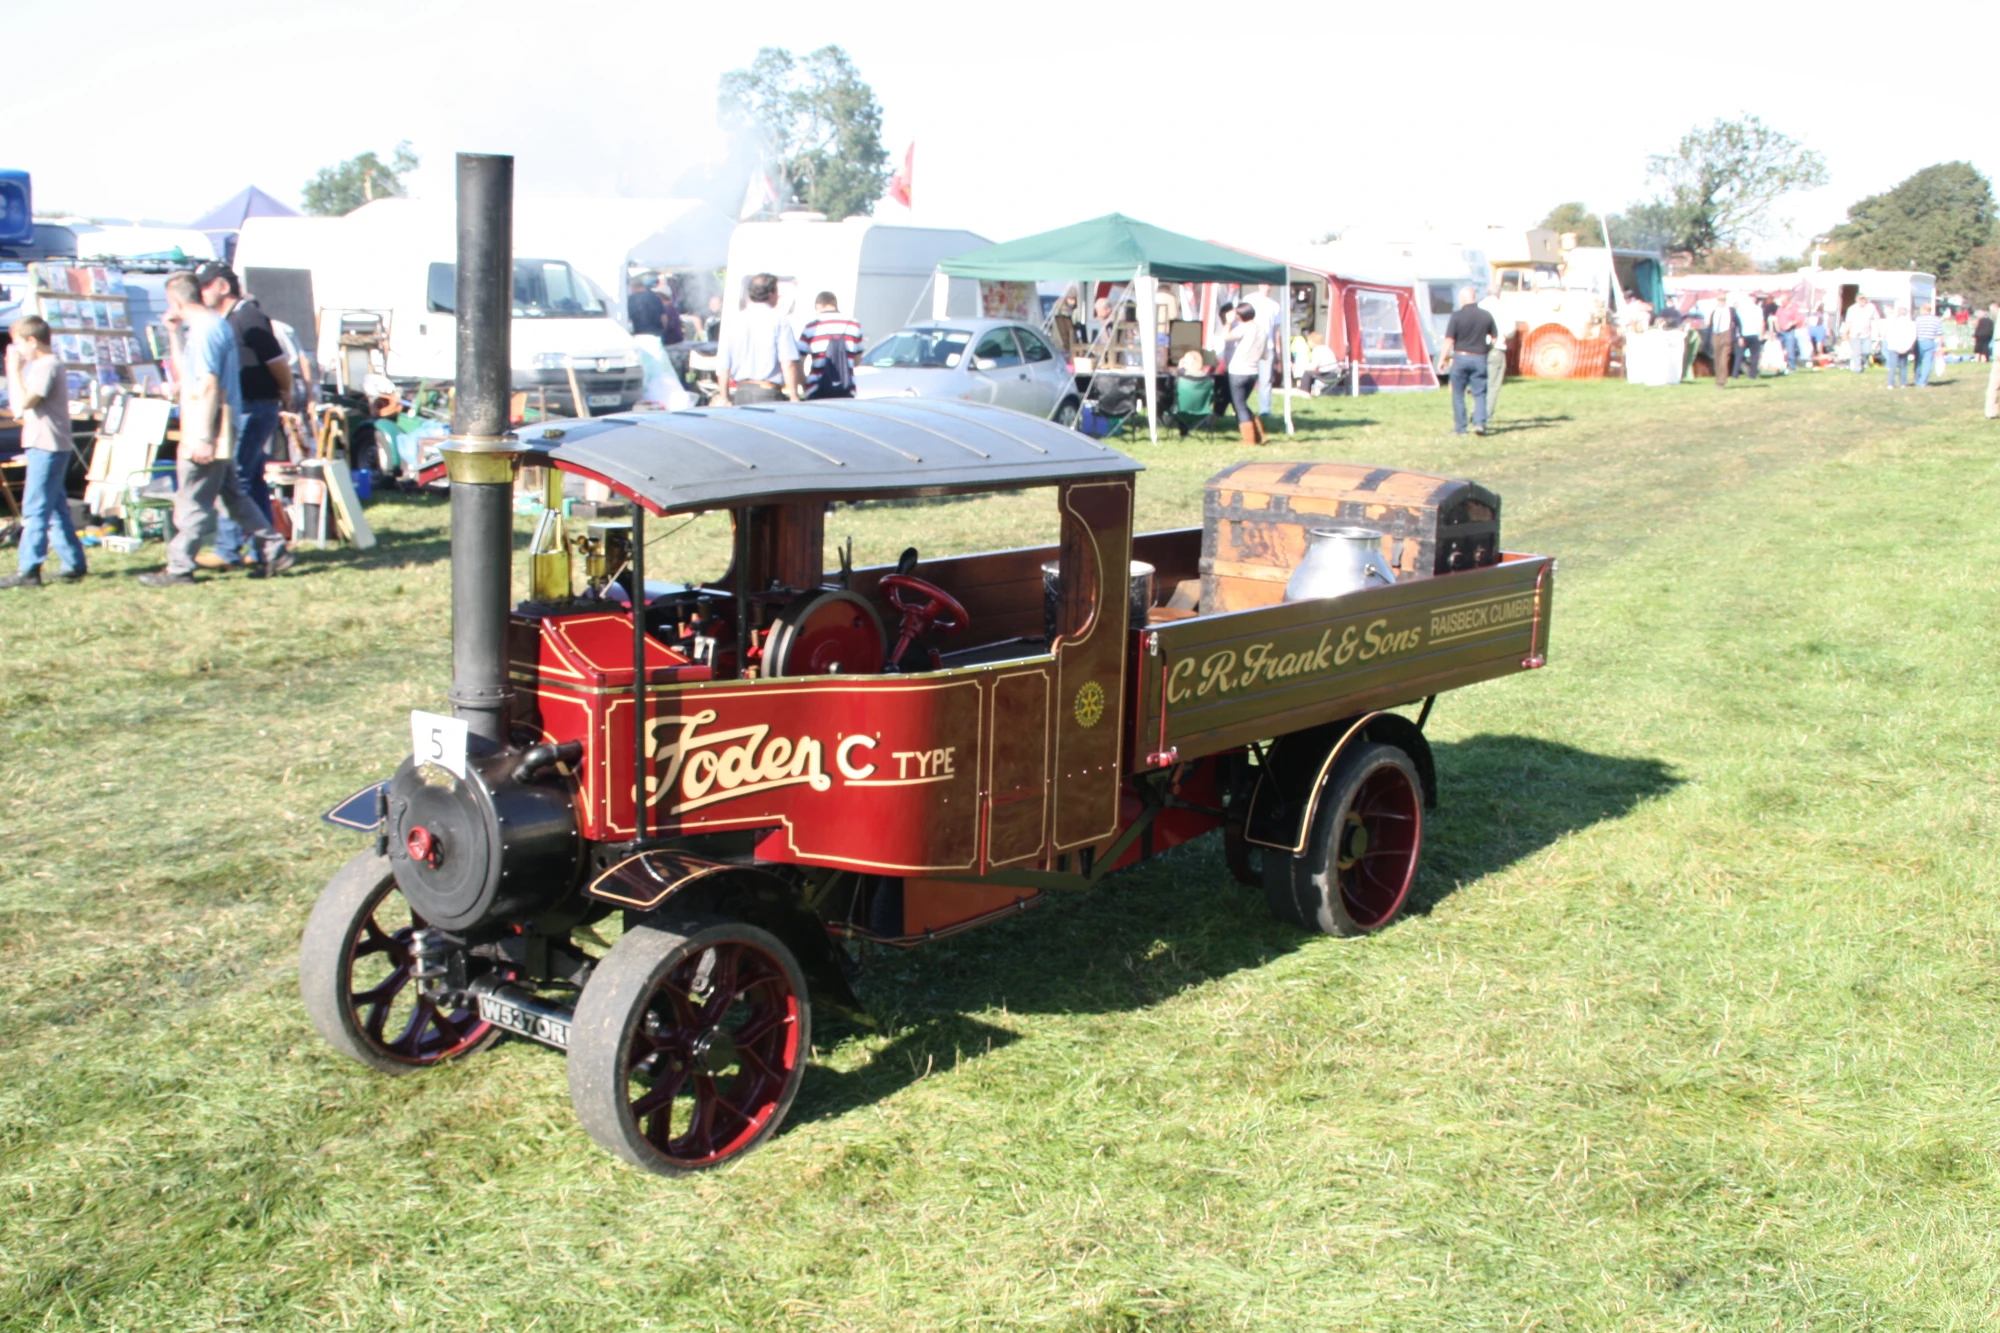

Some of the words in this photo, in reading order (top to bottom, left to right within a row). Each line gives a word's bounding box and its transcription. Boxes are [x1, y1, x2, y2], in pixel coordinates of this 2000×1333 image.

[1358, 619, 1422, 660] Sons
[1430, 608, 1488, 636] RAISBECK
[431, 728, 443, 760] 5
[631, 709, 831, 810] Foden
[892, 747, 955, 779] TYPE
